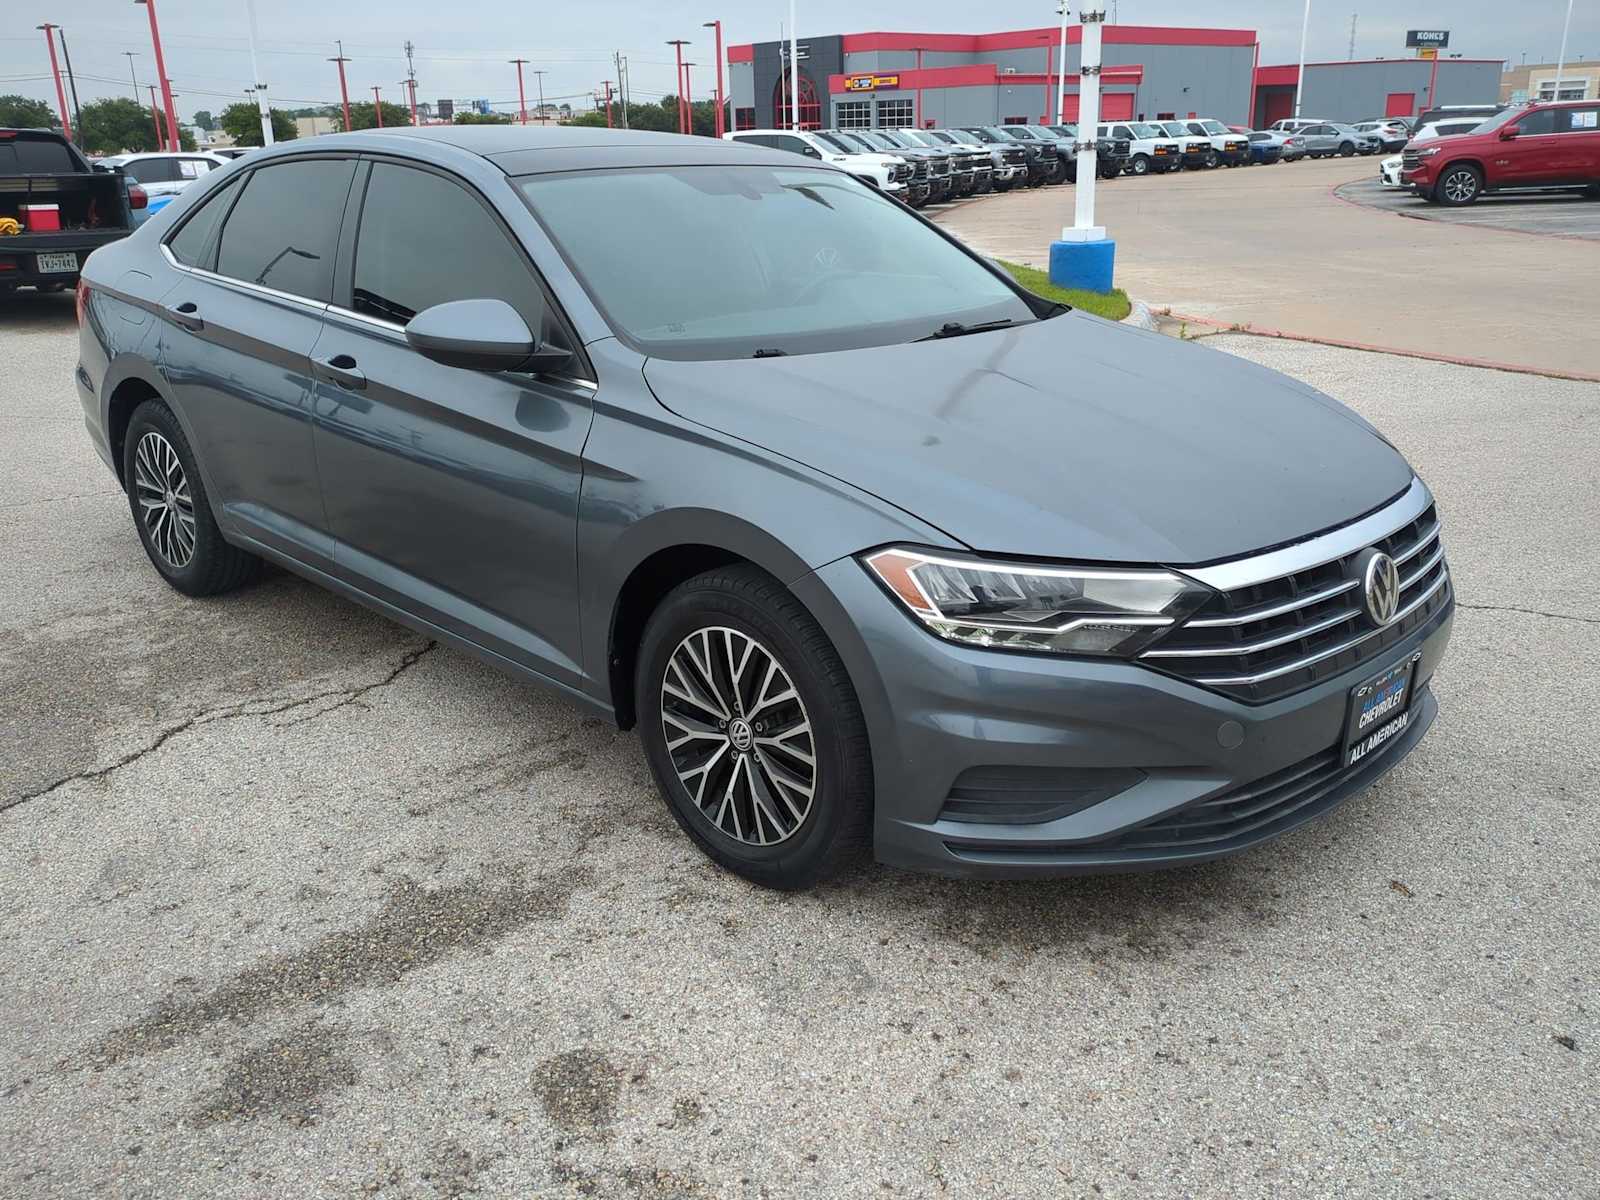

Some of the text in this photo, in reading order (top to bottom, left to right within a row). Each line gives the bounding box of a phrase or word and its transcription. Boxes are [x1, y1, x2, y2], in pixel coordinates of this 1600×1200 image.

[1359, 688, 1403, 728] CHEVROLET
[1350, 712, 1409, 765] ALL AMERICAN
